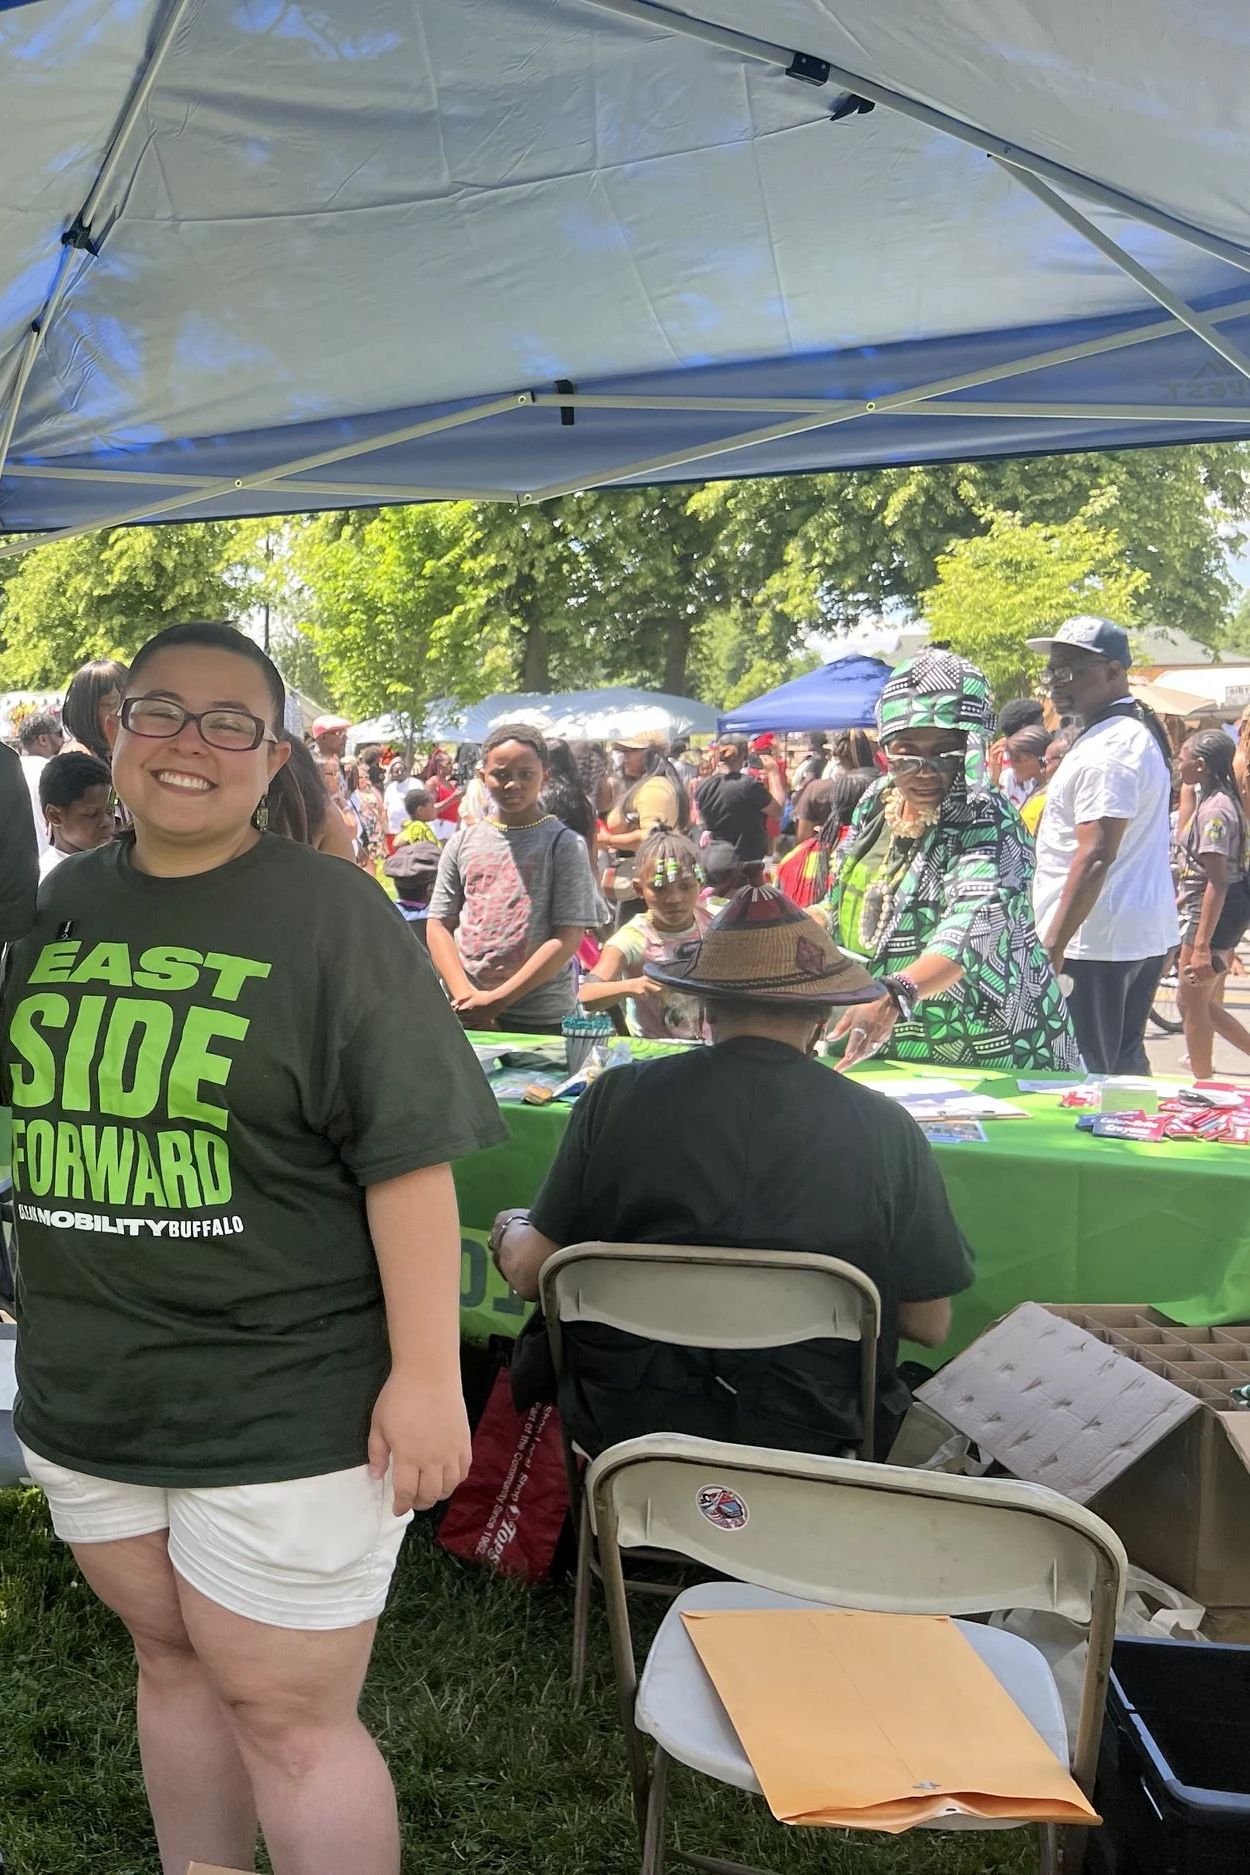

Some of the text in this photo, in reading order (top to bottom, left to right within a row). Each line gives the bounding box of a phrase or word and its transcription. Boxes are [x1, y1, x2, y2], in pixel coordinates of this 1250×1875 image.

[27, 940, 272, 1002] EAST
[8, 992, 251, 1132] SIDE
[11, 1118, 233, 1209] FORWARD
[37, 1207, 170, 1238] MOBILITY
[167, 1214, 246, 1239] BUFFALO
[486, 1504, 504, 1530] Since
